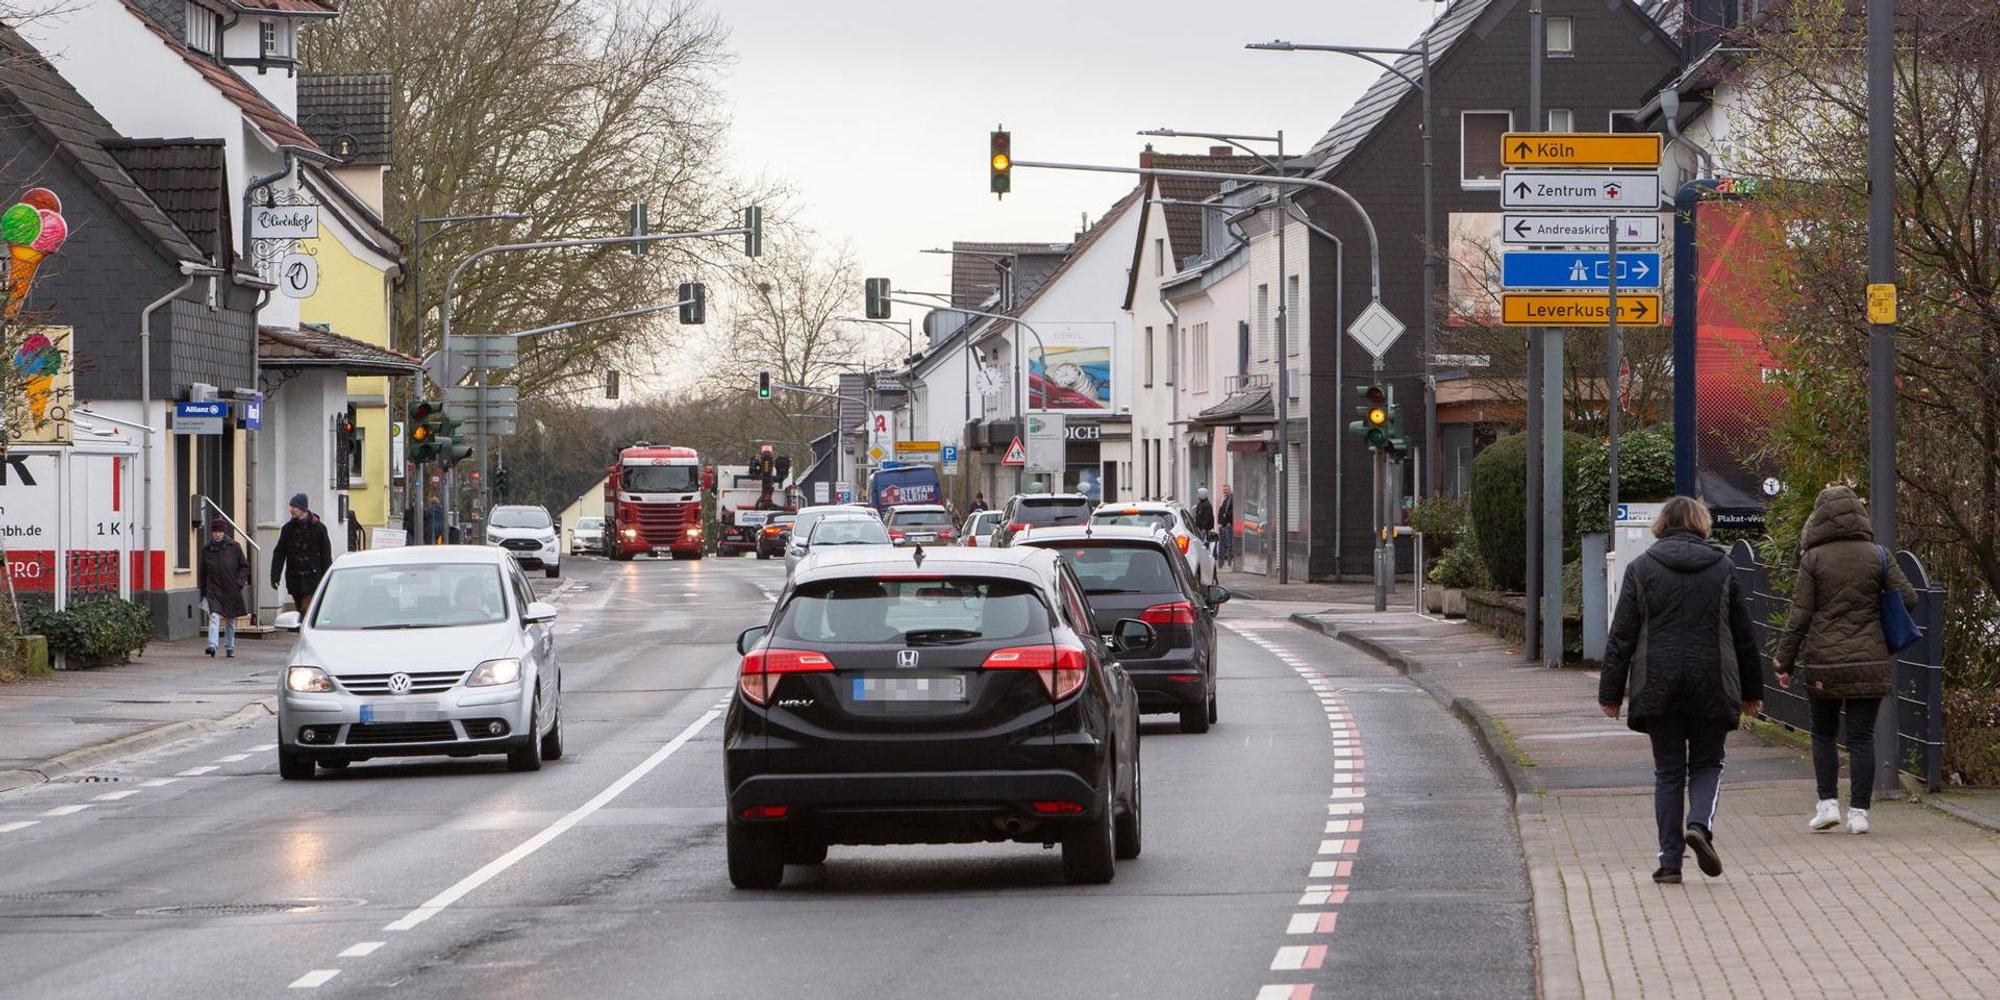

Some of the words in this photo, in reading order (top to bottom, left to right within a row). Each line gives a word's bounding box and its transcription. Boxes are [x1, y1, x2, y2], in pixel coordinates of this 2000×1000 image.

[1537, 143, 1575, 158] Köln
[1537, 184, 1597, 197] Zentrum
[257, 211, 313, 232] Olivenhof
[185, 405, 210, 413] Allianz
[900, 485, 934, 495] STEFAN
[900, 491, 928, 502] KLEIN
